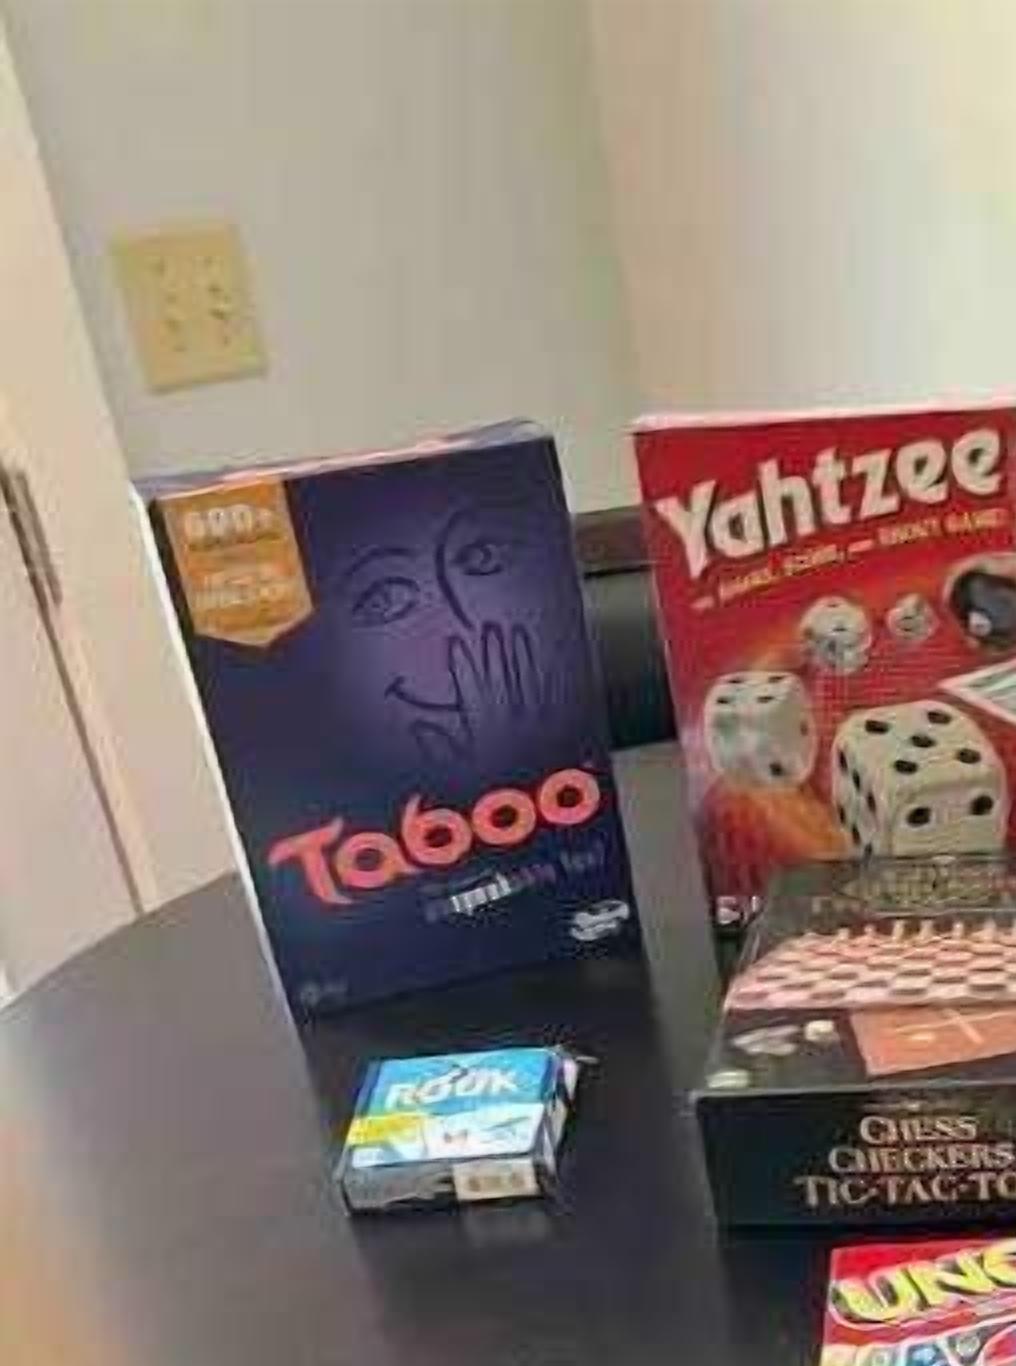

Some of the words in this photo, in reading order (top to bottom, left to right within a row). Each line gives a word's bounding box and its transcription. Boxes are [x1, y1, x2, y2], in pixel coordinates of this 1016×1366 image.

[656, 427, 1004, 581] Yahtzee
[268, 768, 601, 906] Taboo
[827, 1142, 1015, 1174] CHECKERS
